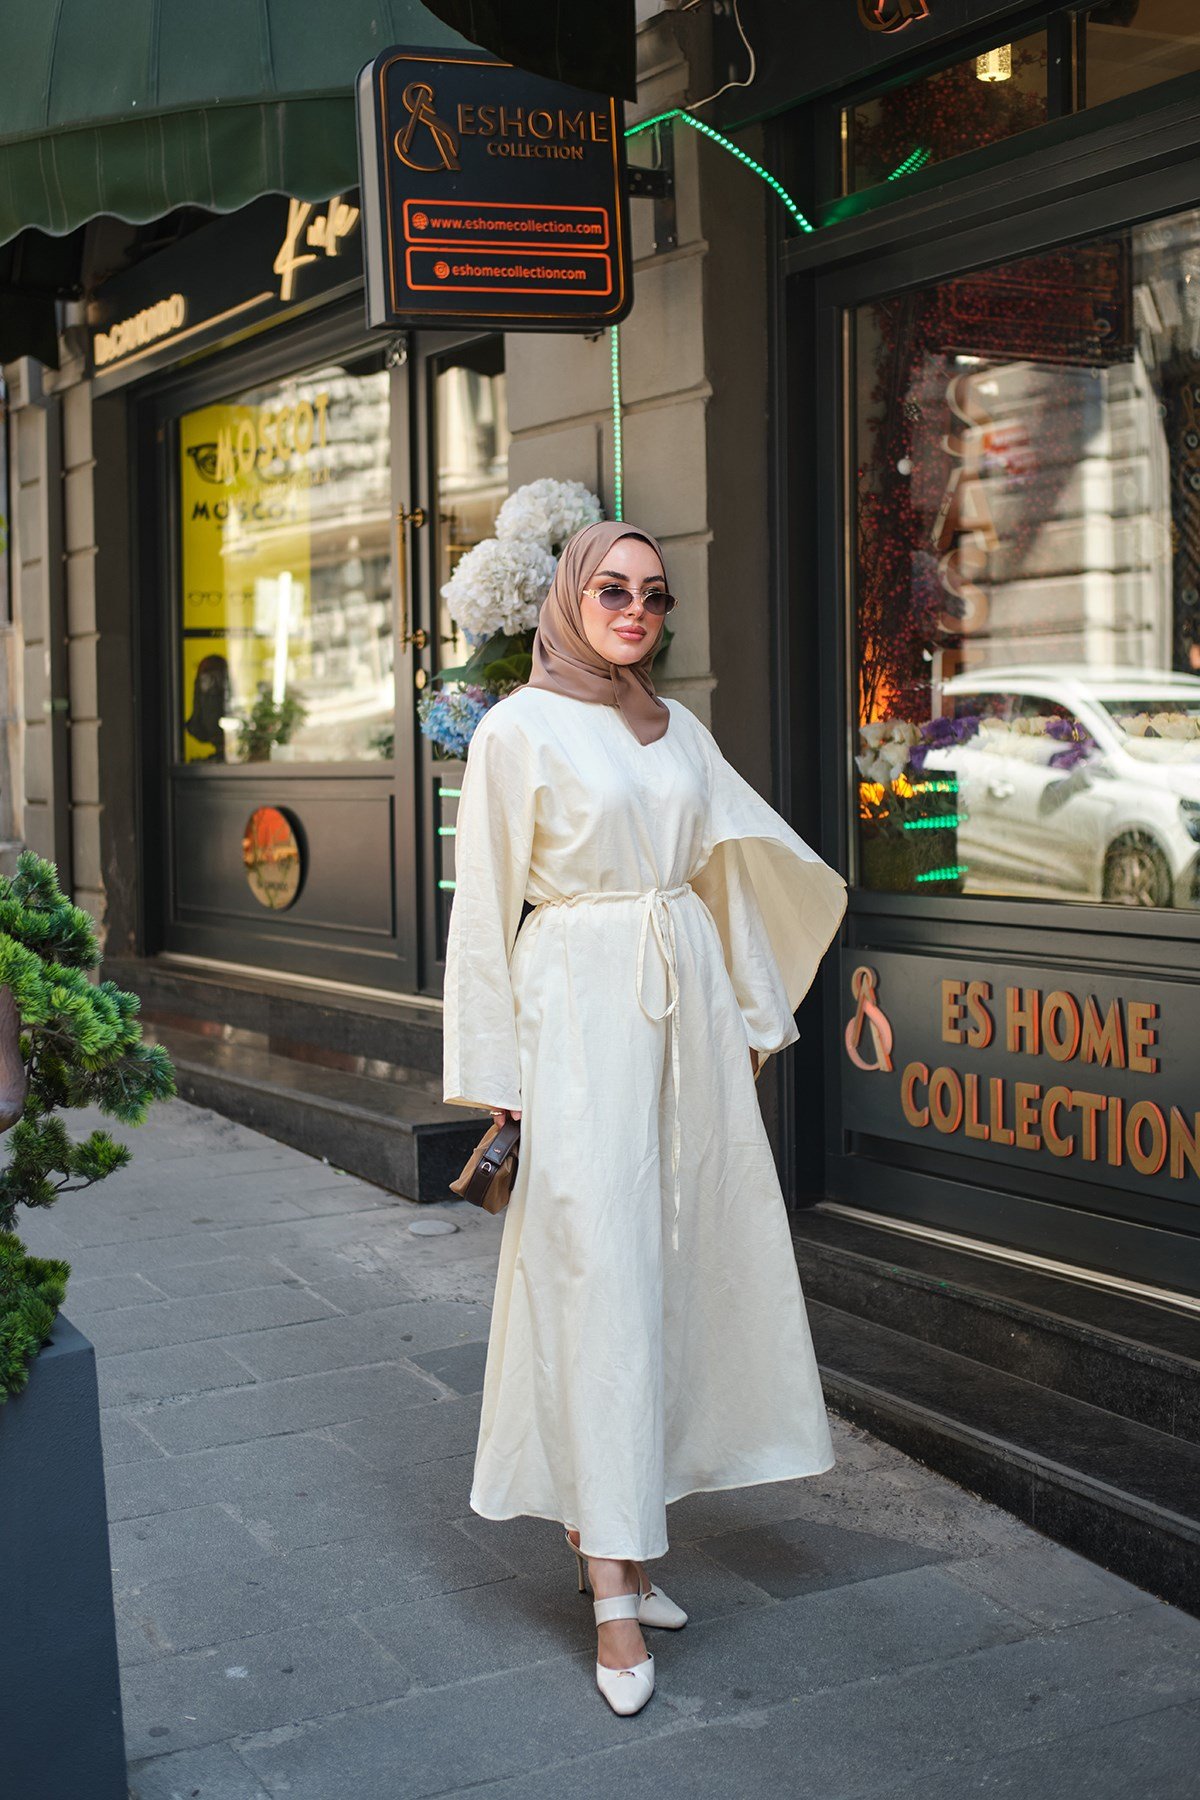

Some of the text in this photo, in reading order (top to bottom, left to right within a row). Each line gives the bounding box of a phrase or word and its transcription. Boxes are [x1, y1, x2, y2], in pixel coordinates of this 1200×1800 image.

[457, 103, 609, 142] ESHOME
[487, 142, 584, 160] COLLECTION
[430, 217, 602, 234] www.eshomecollection.com
[452, 263, 587, 280] eshomecollectioncom
[215, 392, 329, 482] MOSCOT
[942, 979, 1157, 1074] ES HOME
[901, 1061, 1200, 1180] COLLECTION
